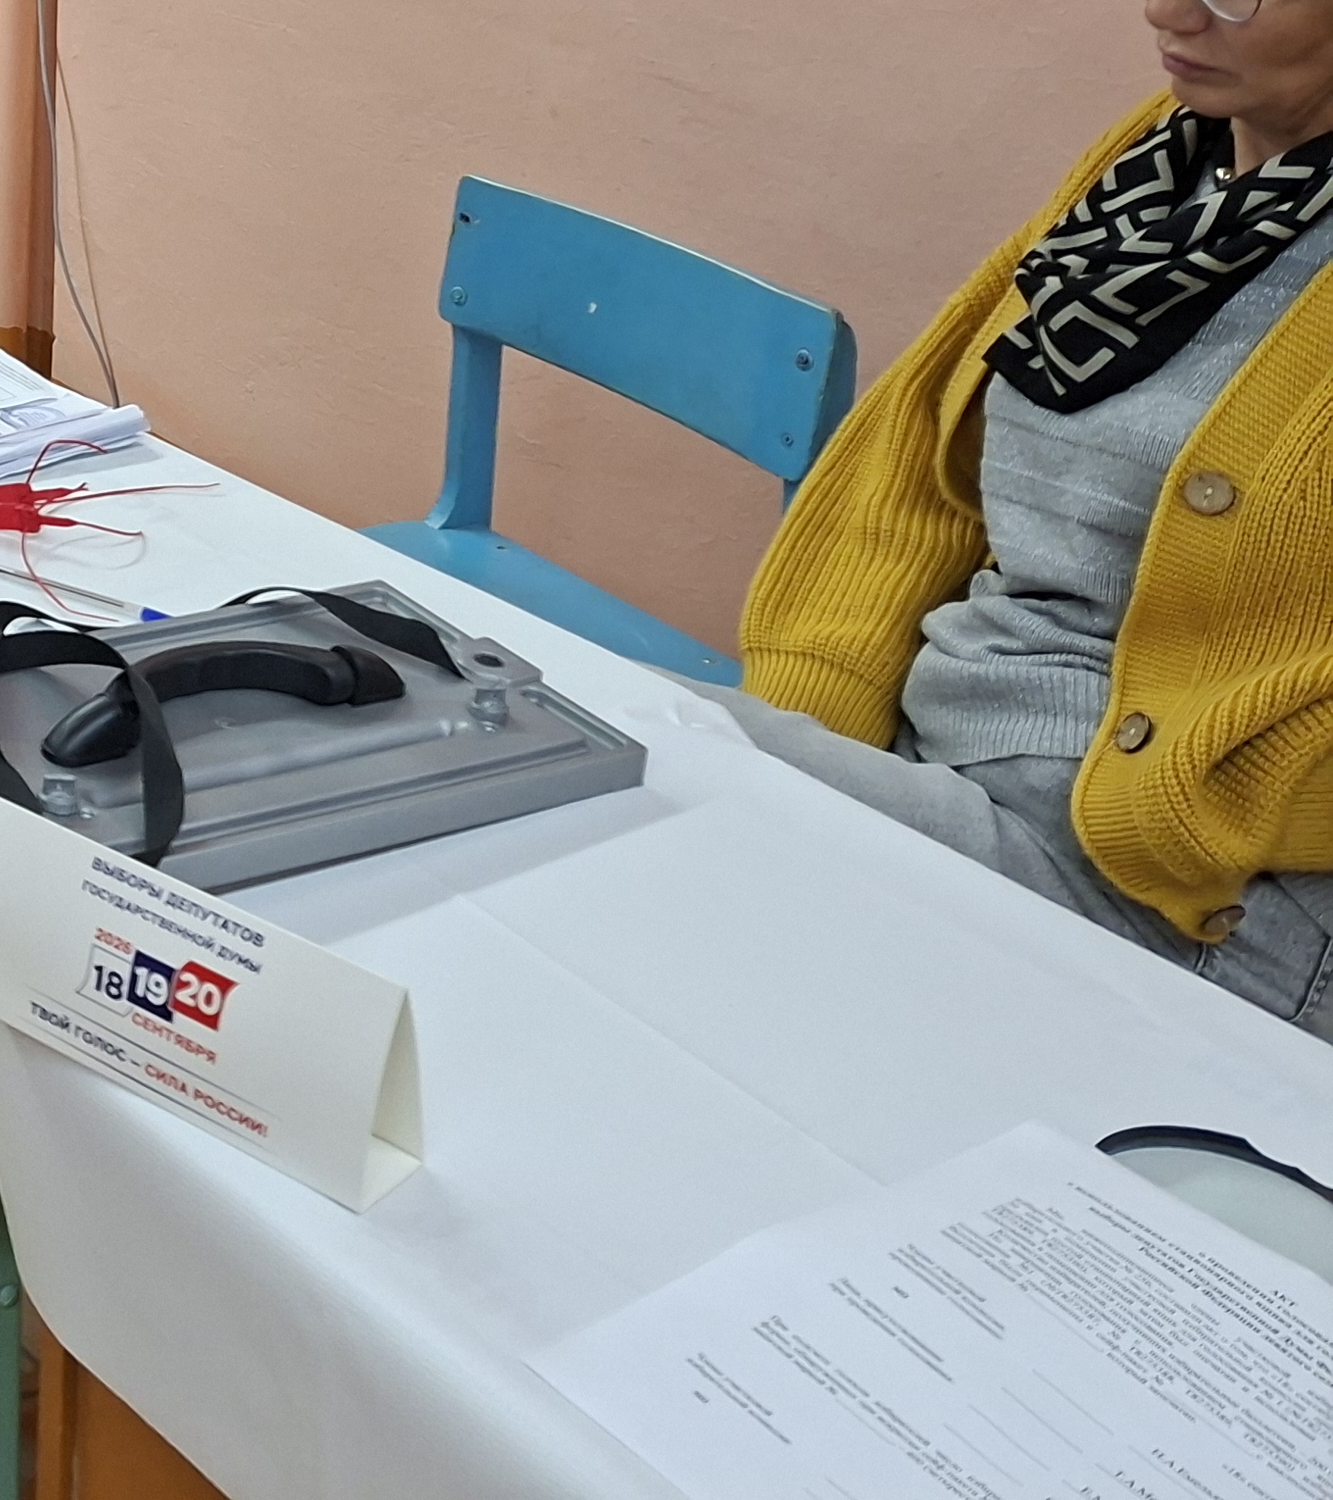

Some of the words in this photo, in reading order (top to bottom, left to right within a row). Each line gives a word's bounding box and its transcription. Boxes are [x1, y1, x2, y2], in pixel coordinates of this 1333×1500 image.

[81, 879, 216, 953] ГОСУДАРСТВЕННОЙ
[215, 944, 263, 974] ДУМЫ
[90, 855, 165, 902] ВЫБОРЫ
[165, 890, 267, 949] ДЕПУТАТОВ
[93, 927, 133, 955] 2026
[92, 963, 125, 1003] 18
[134, 965, 170, 1008] 19
[177, 971, 220, 1017] 20
[29, 1000, 72, 1035] ТВОЙ
[73, 1020, 129, 1064] ГОЛОС
[143, 1061, 189, 1098] СИЛА
[192, 1088, 269, 1138] РОССИИ!
[131, 1011, 218, 1065] СЕНТЯБРЯ
[1138, 1246, 1200, 1290] Российской
[1201, 1289, 1261, 1334] Федерации
[1187, 1267, 1280, 1335] Государственной
[1282, 1336, 1314, 1361] Думы
[1207, 1257, 1275, 1304] проведении
[1273, 1290, 1296, 1307] АКТ
